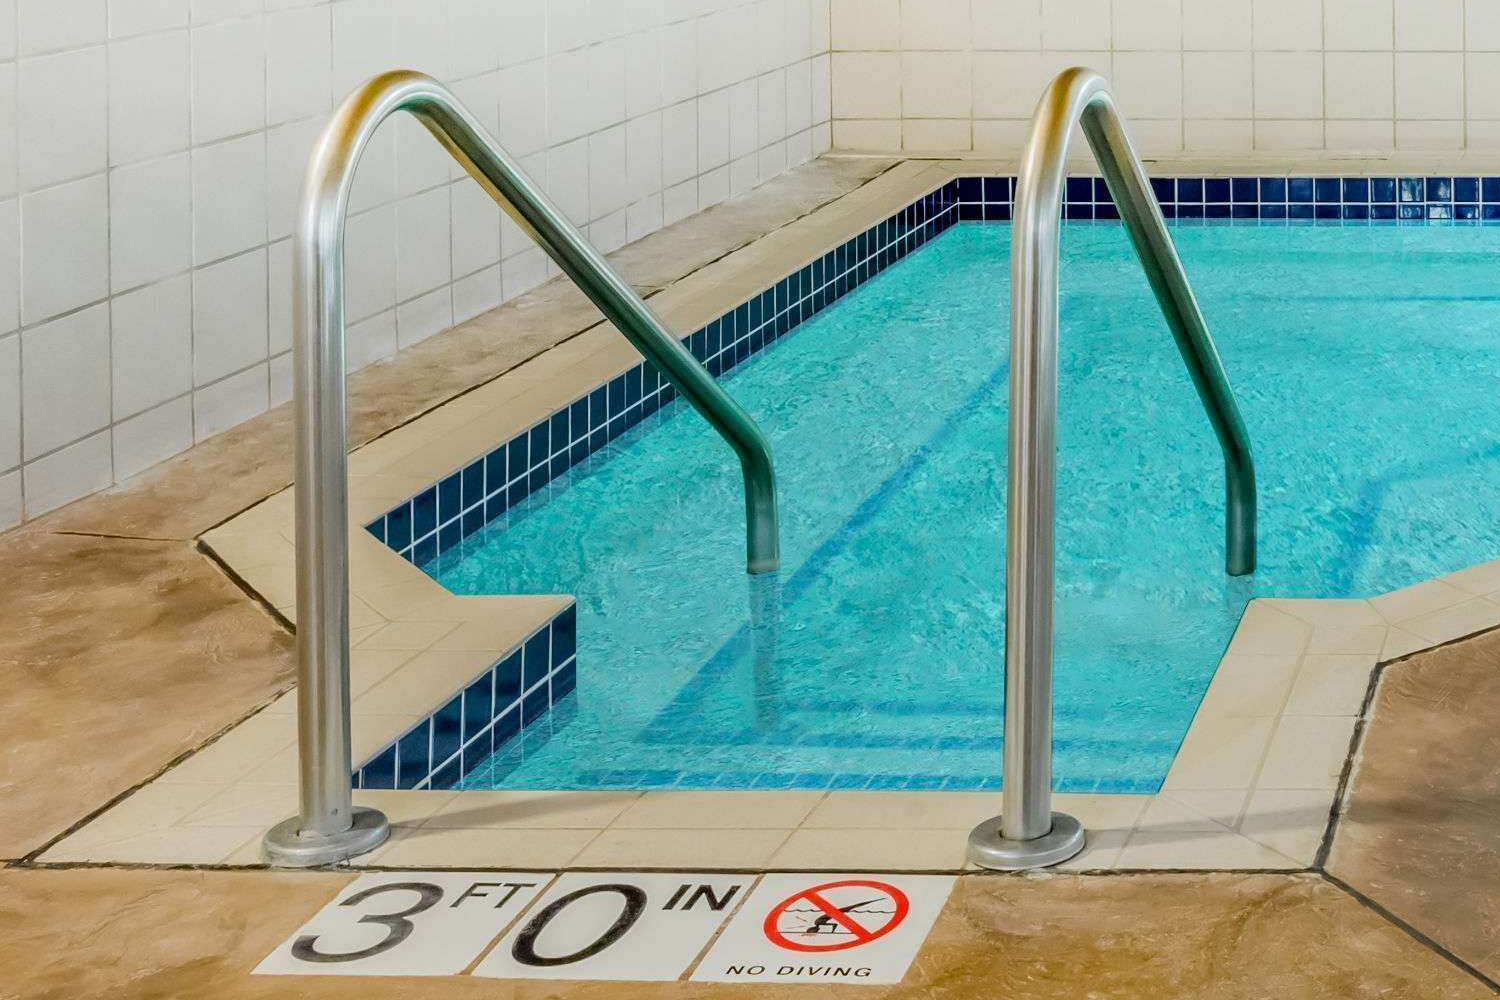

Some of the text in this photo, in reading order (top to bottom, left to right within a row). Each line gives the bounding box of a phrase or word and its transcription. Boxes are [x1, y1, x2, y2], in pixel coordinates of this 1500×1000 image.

[291, 882, 742, 967] 3 FT 0 IN
[725, 965, 872, 978] NO DIVING
